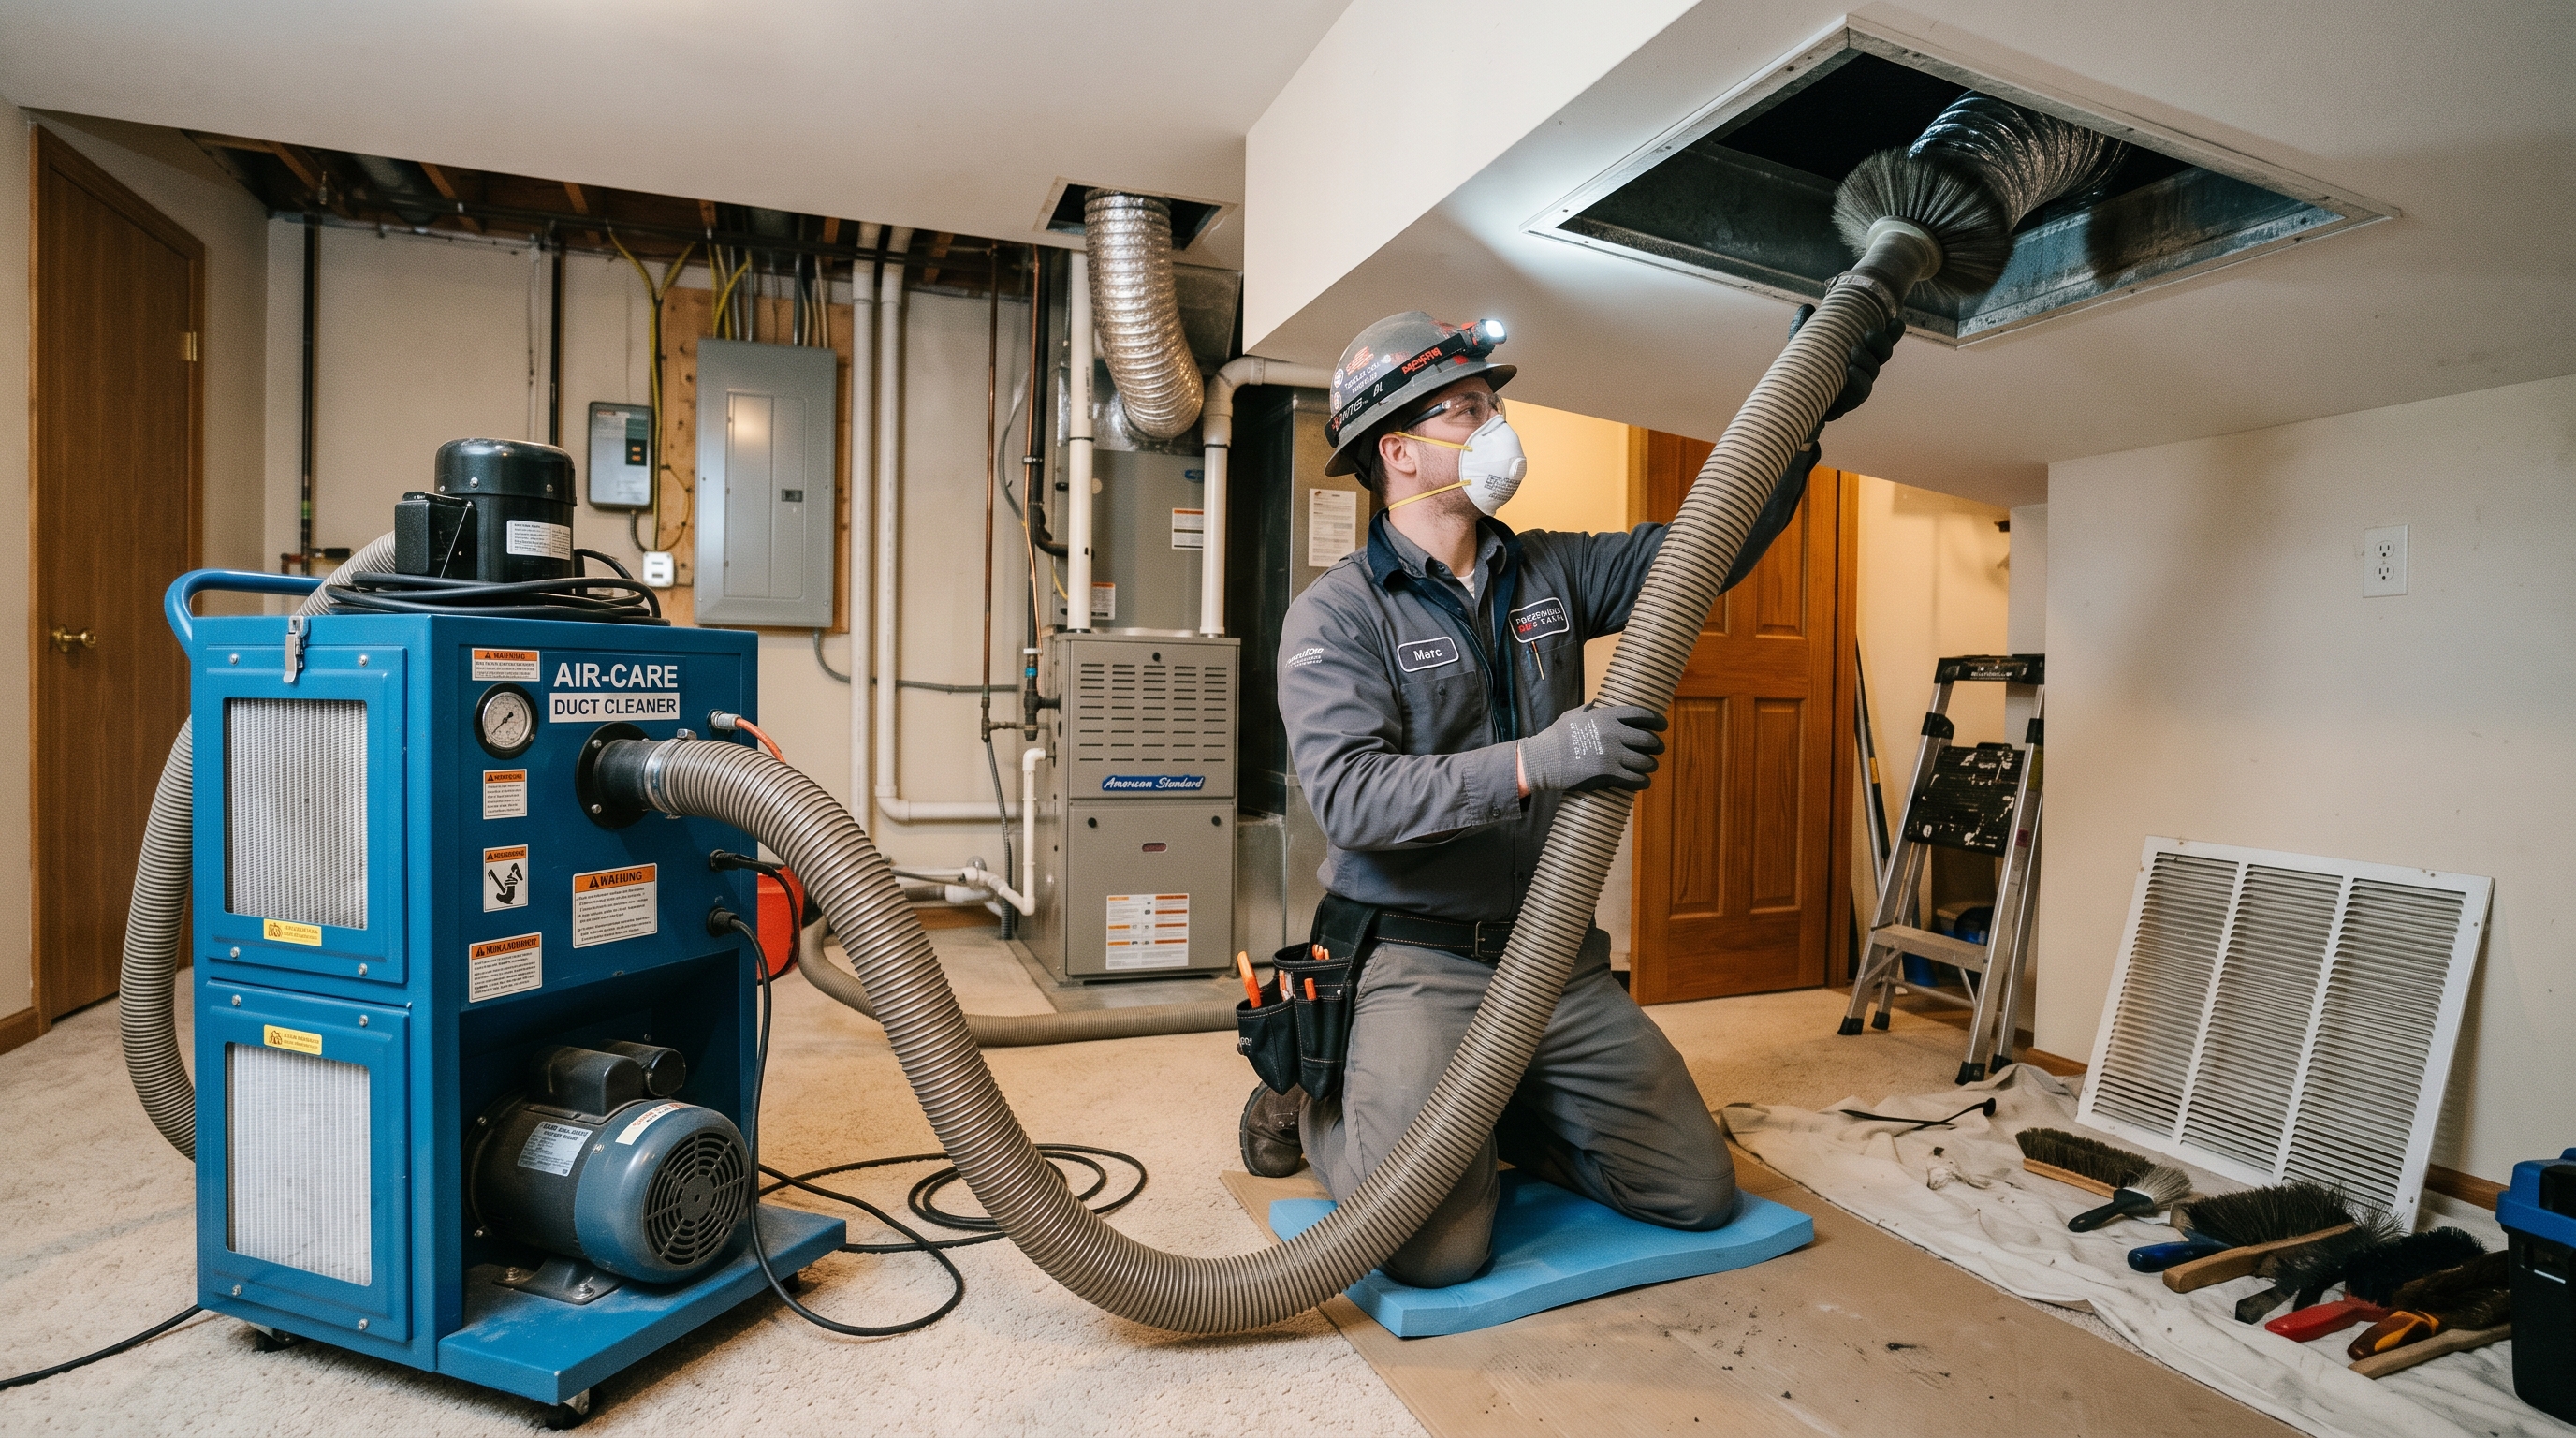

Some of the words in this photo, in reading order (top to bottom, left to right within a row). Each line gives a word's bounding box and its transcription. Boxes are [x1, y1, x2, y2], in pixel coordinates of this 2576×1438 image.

[1413, 649, 1442, 661] Marc
[553, 662, 678, 688] AIR-CARE
[554, 698, 600, 715] DUCT
[604, 698, 677, 714] CLEANER
[1103, 777, 1153, 789] American
[1155, 776, 1204, 789] Standard
